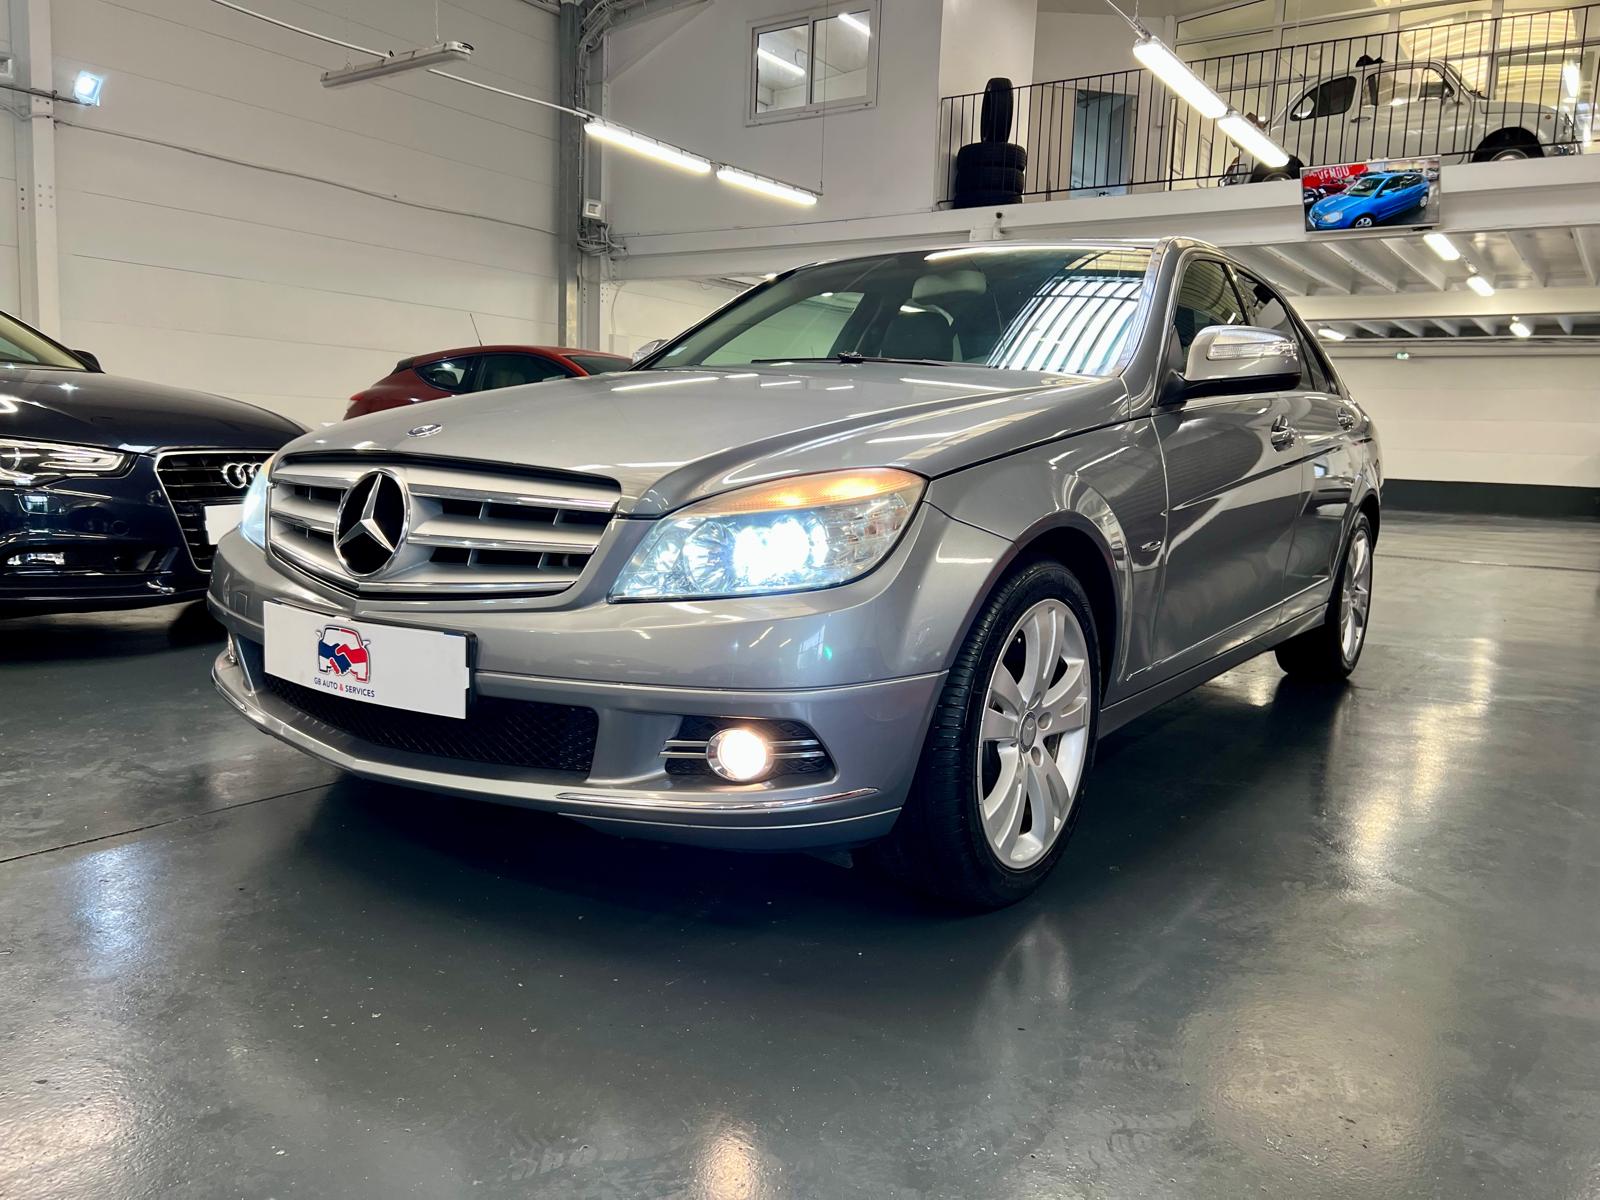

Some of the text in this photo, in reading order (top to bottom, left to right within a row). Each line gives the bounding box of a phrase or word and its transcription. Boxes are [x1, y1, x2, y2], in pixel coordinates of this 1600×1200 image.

[1317, 166, 1351, 180] VENDU
[322, 679, 338, 690] AUTO
[339, 683, 344, 692] &
[345, 685, 376, 698] SERVICES
